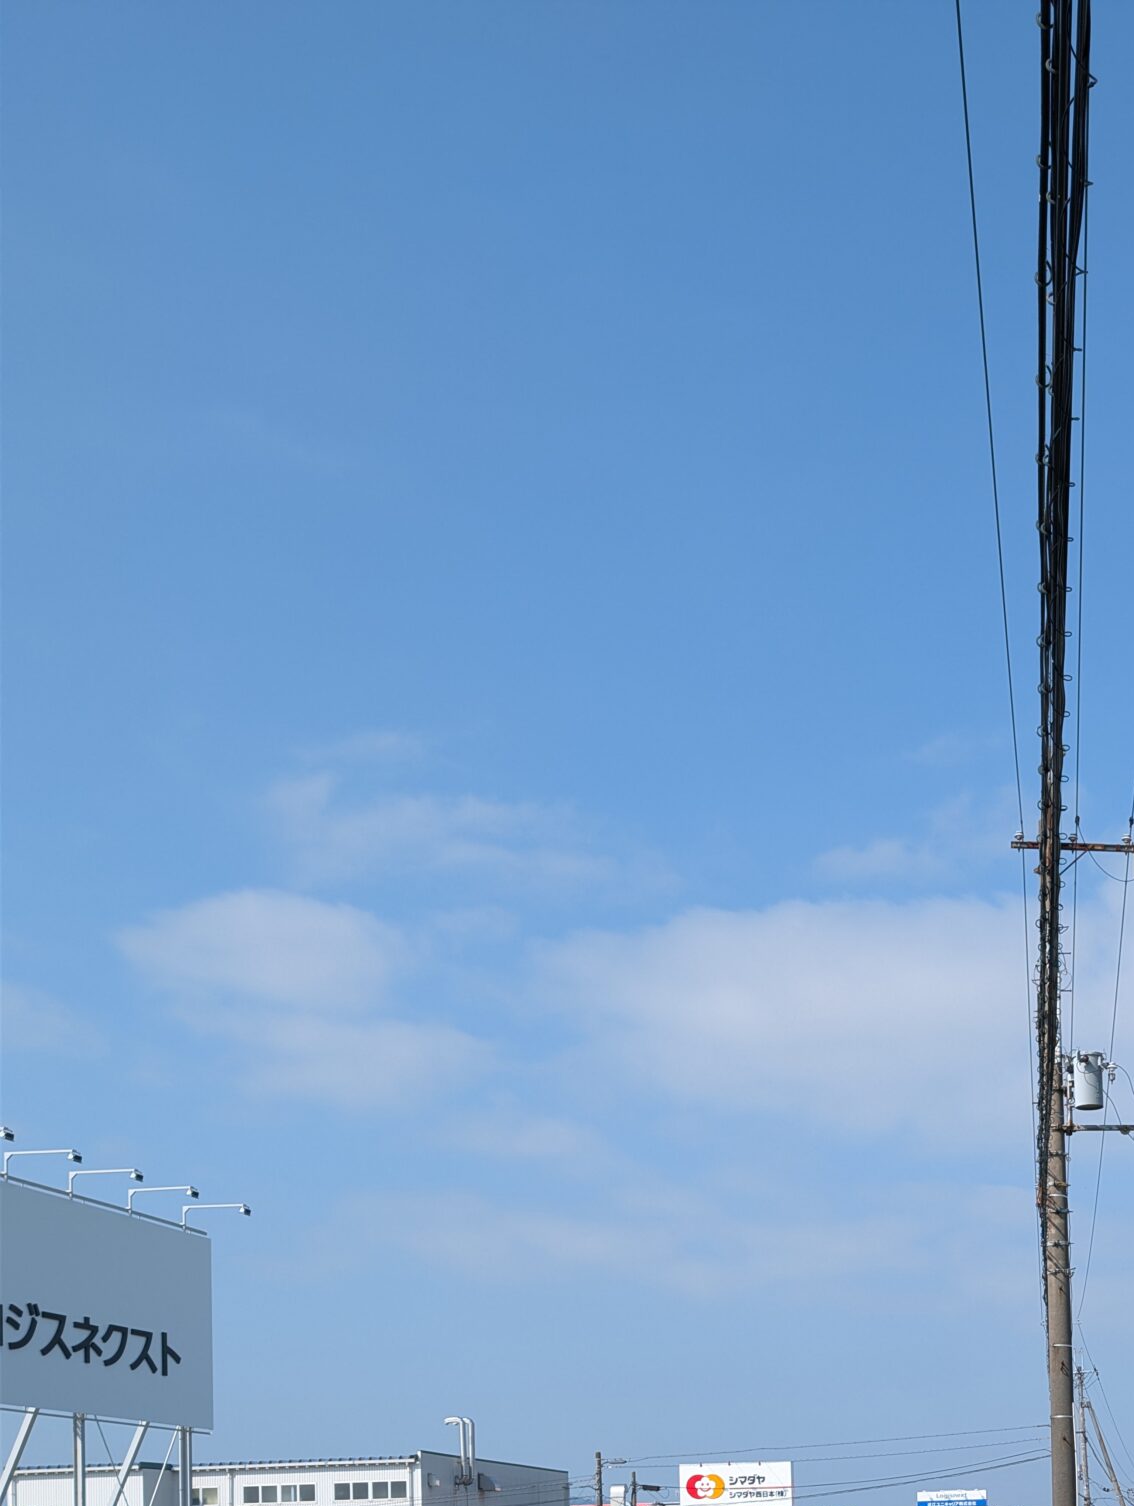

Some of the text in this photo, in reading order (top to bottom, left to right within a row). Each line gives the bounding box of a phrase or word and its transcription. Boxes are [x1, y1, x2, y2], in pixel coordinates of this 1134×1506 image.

[0, 1303, 181, 1376] ジスネクスト
[729, 1474, 766, 1486] シマダヤ
